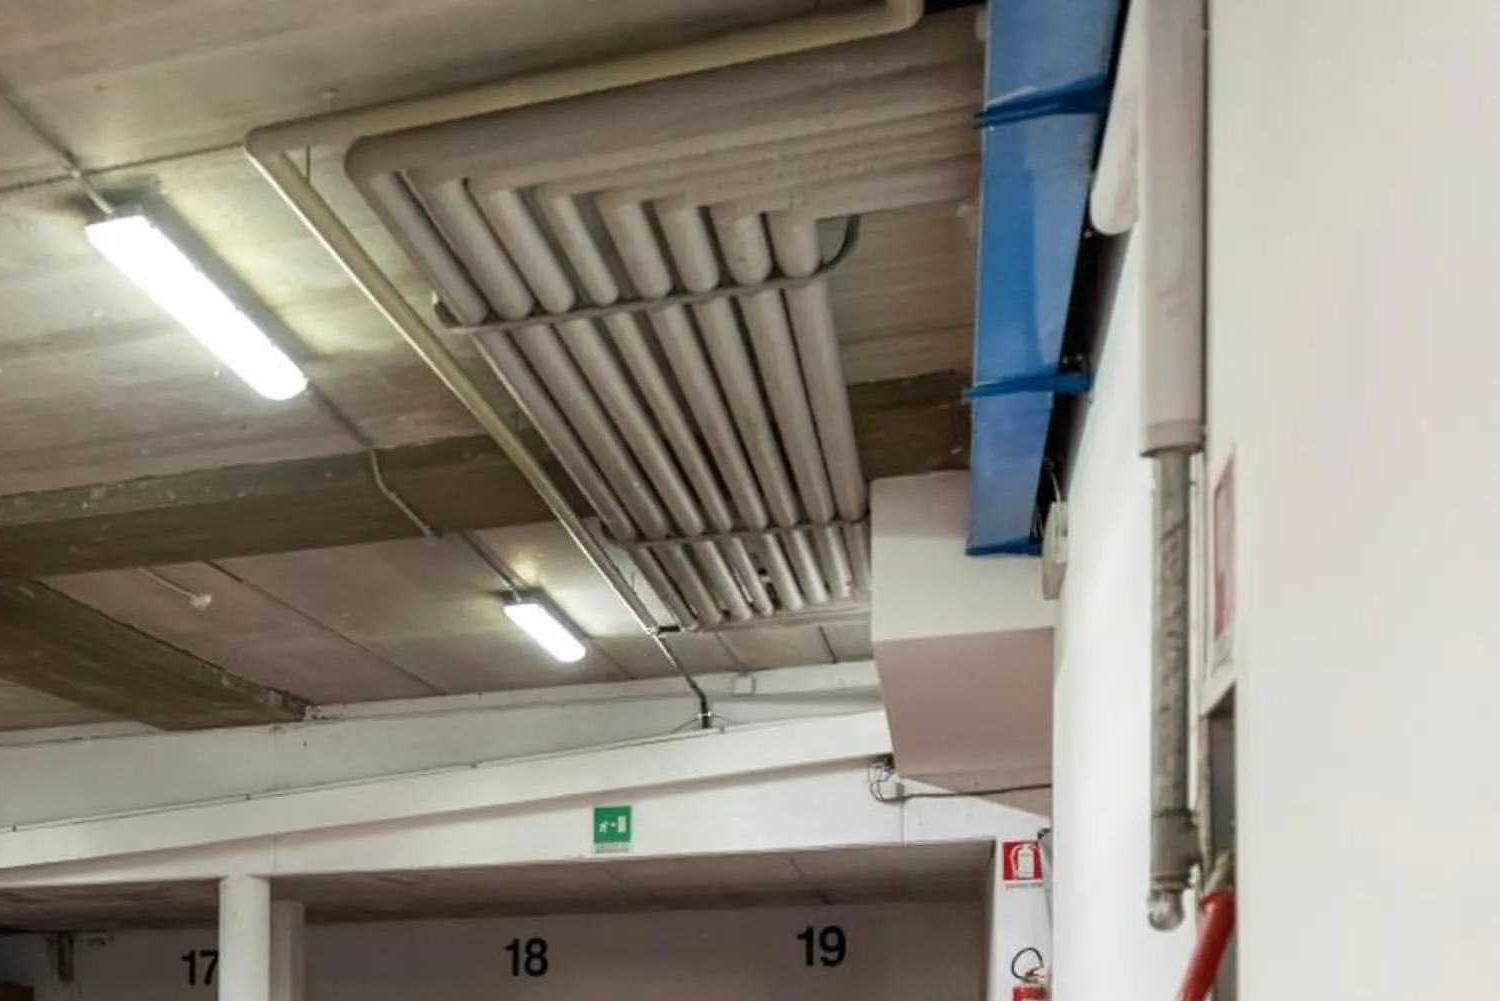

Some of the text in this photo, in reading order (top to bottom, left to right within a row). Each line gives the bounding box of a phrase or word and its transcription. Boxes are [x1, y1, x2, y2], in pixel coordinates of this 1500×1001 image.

[180, 948, 219, 987] 17
[504, 936, 550, 978] 18
[796, 924, 848, 969] 19
